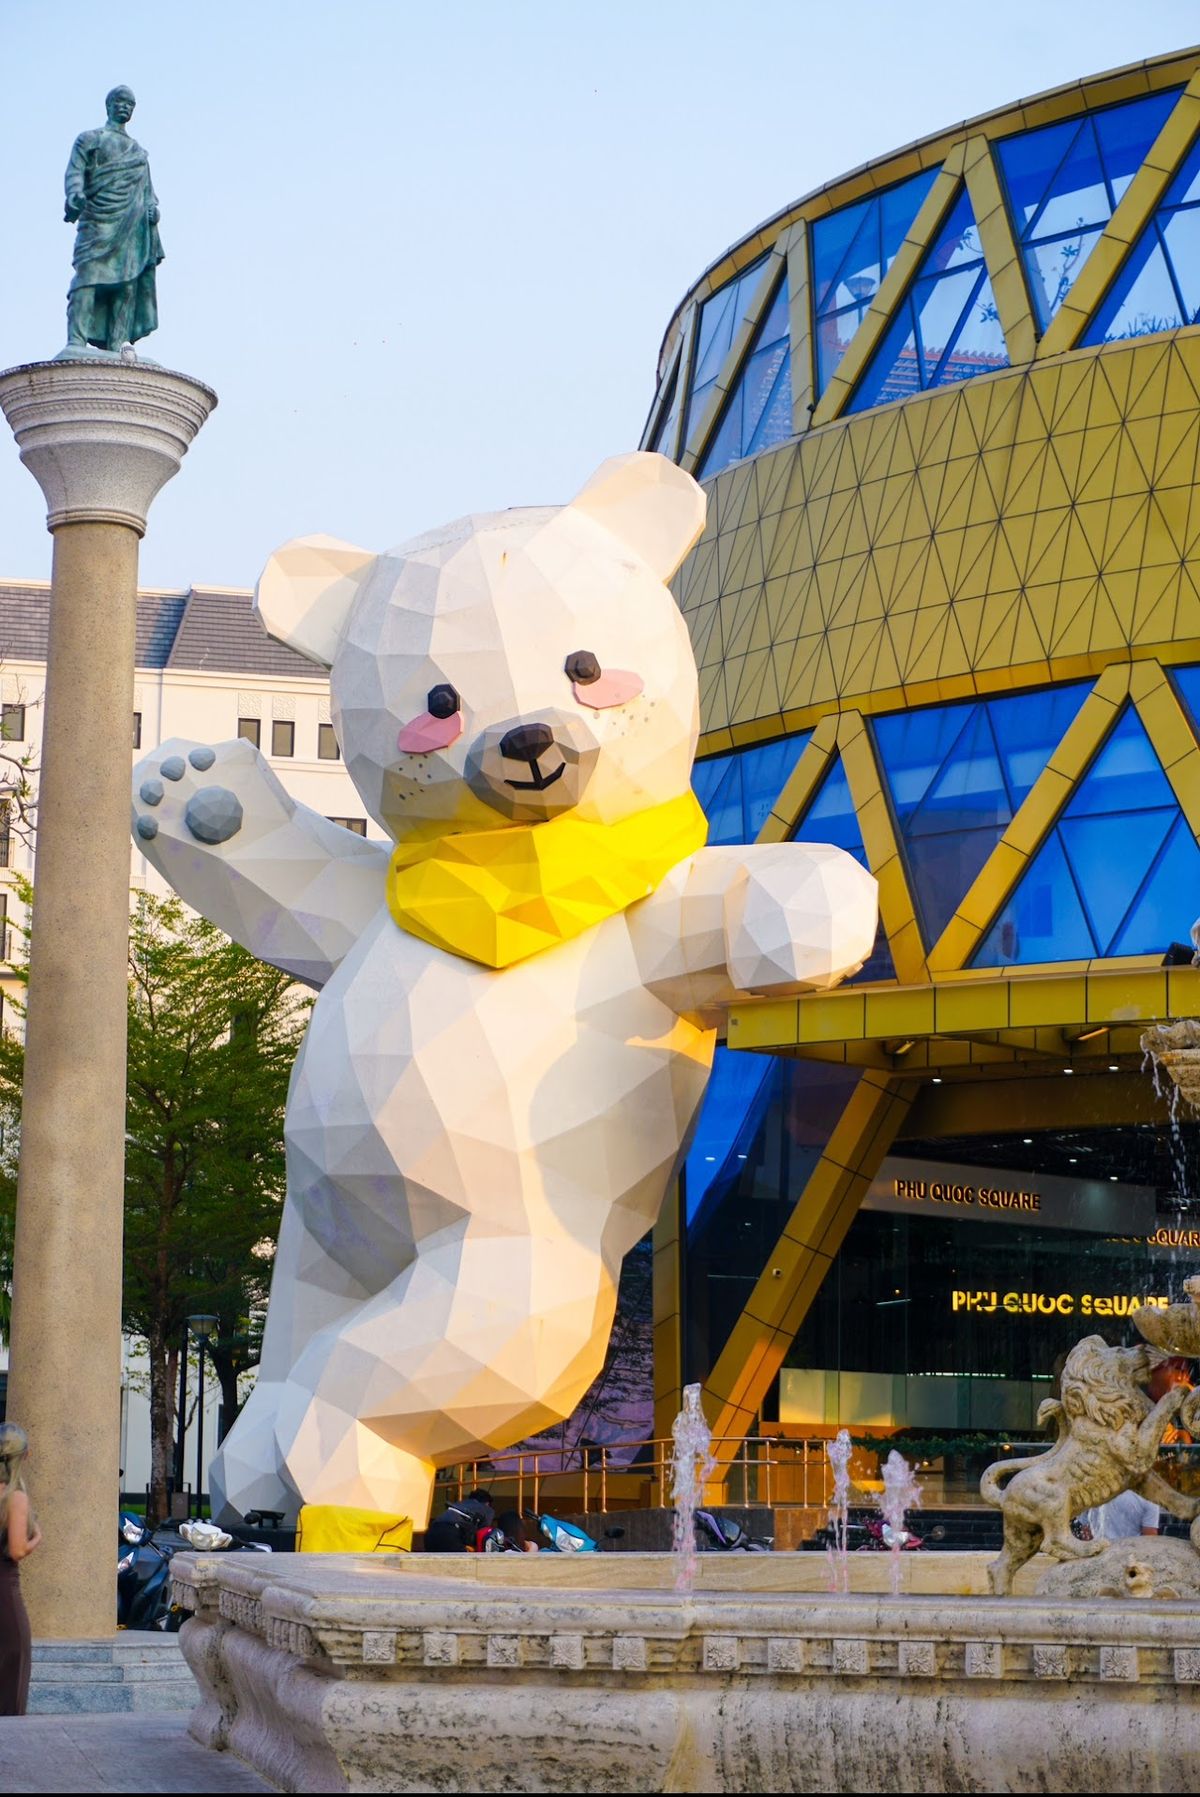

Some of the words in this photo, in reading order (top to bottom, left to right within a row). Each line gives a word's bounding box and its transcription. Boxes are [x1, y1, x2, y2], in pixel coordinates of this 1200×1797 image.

[894, 1179, 927, 1199] PHU
[930, 1183, 975, 1204] QUOC
[978, 1188, 1041, 1211] SQUARE
[952, 1290, 998, 1312] PHU
[1003, 1291, 1074, 1314] QUOC
